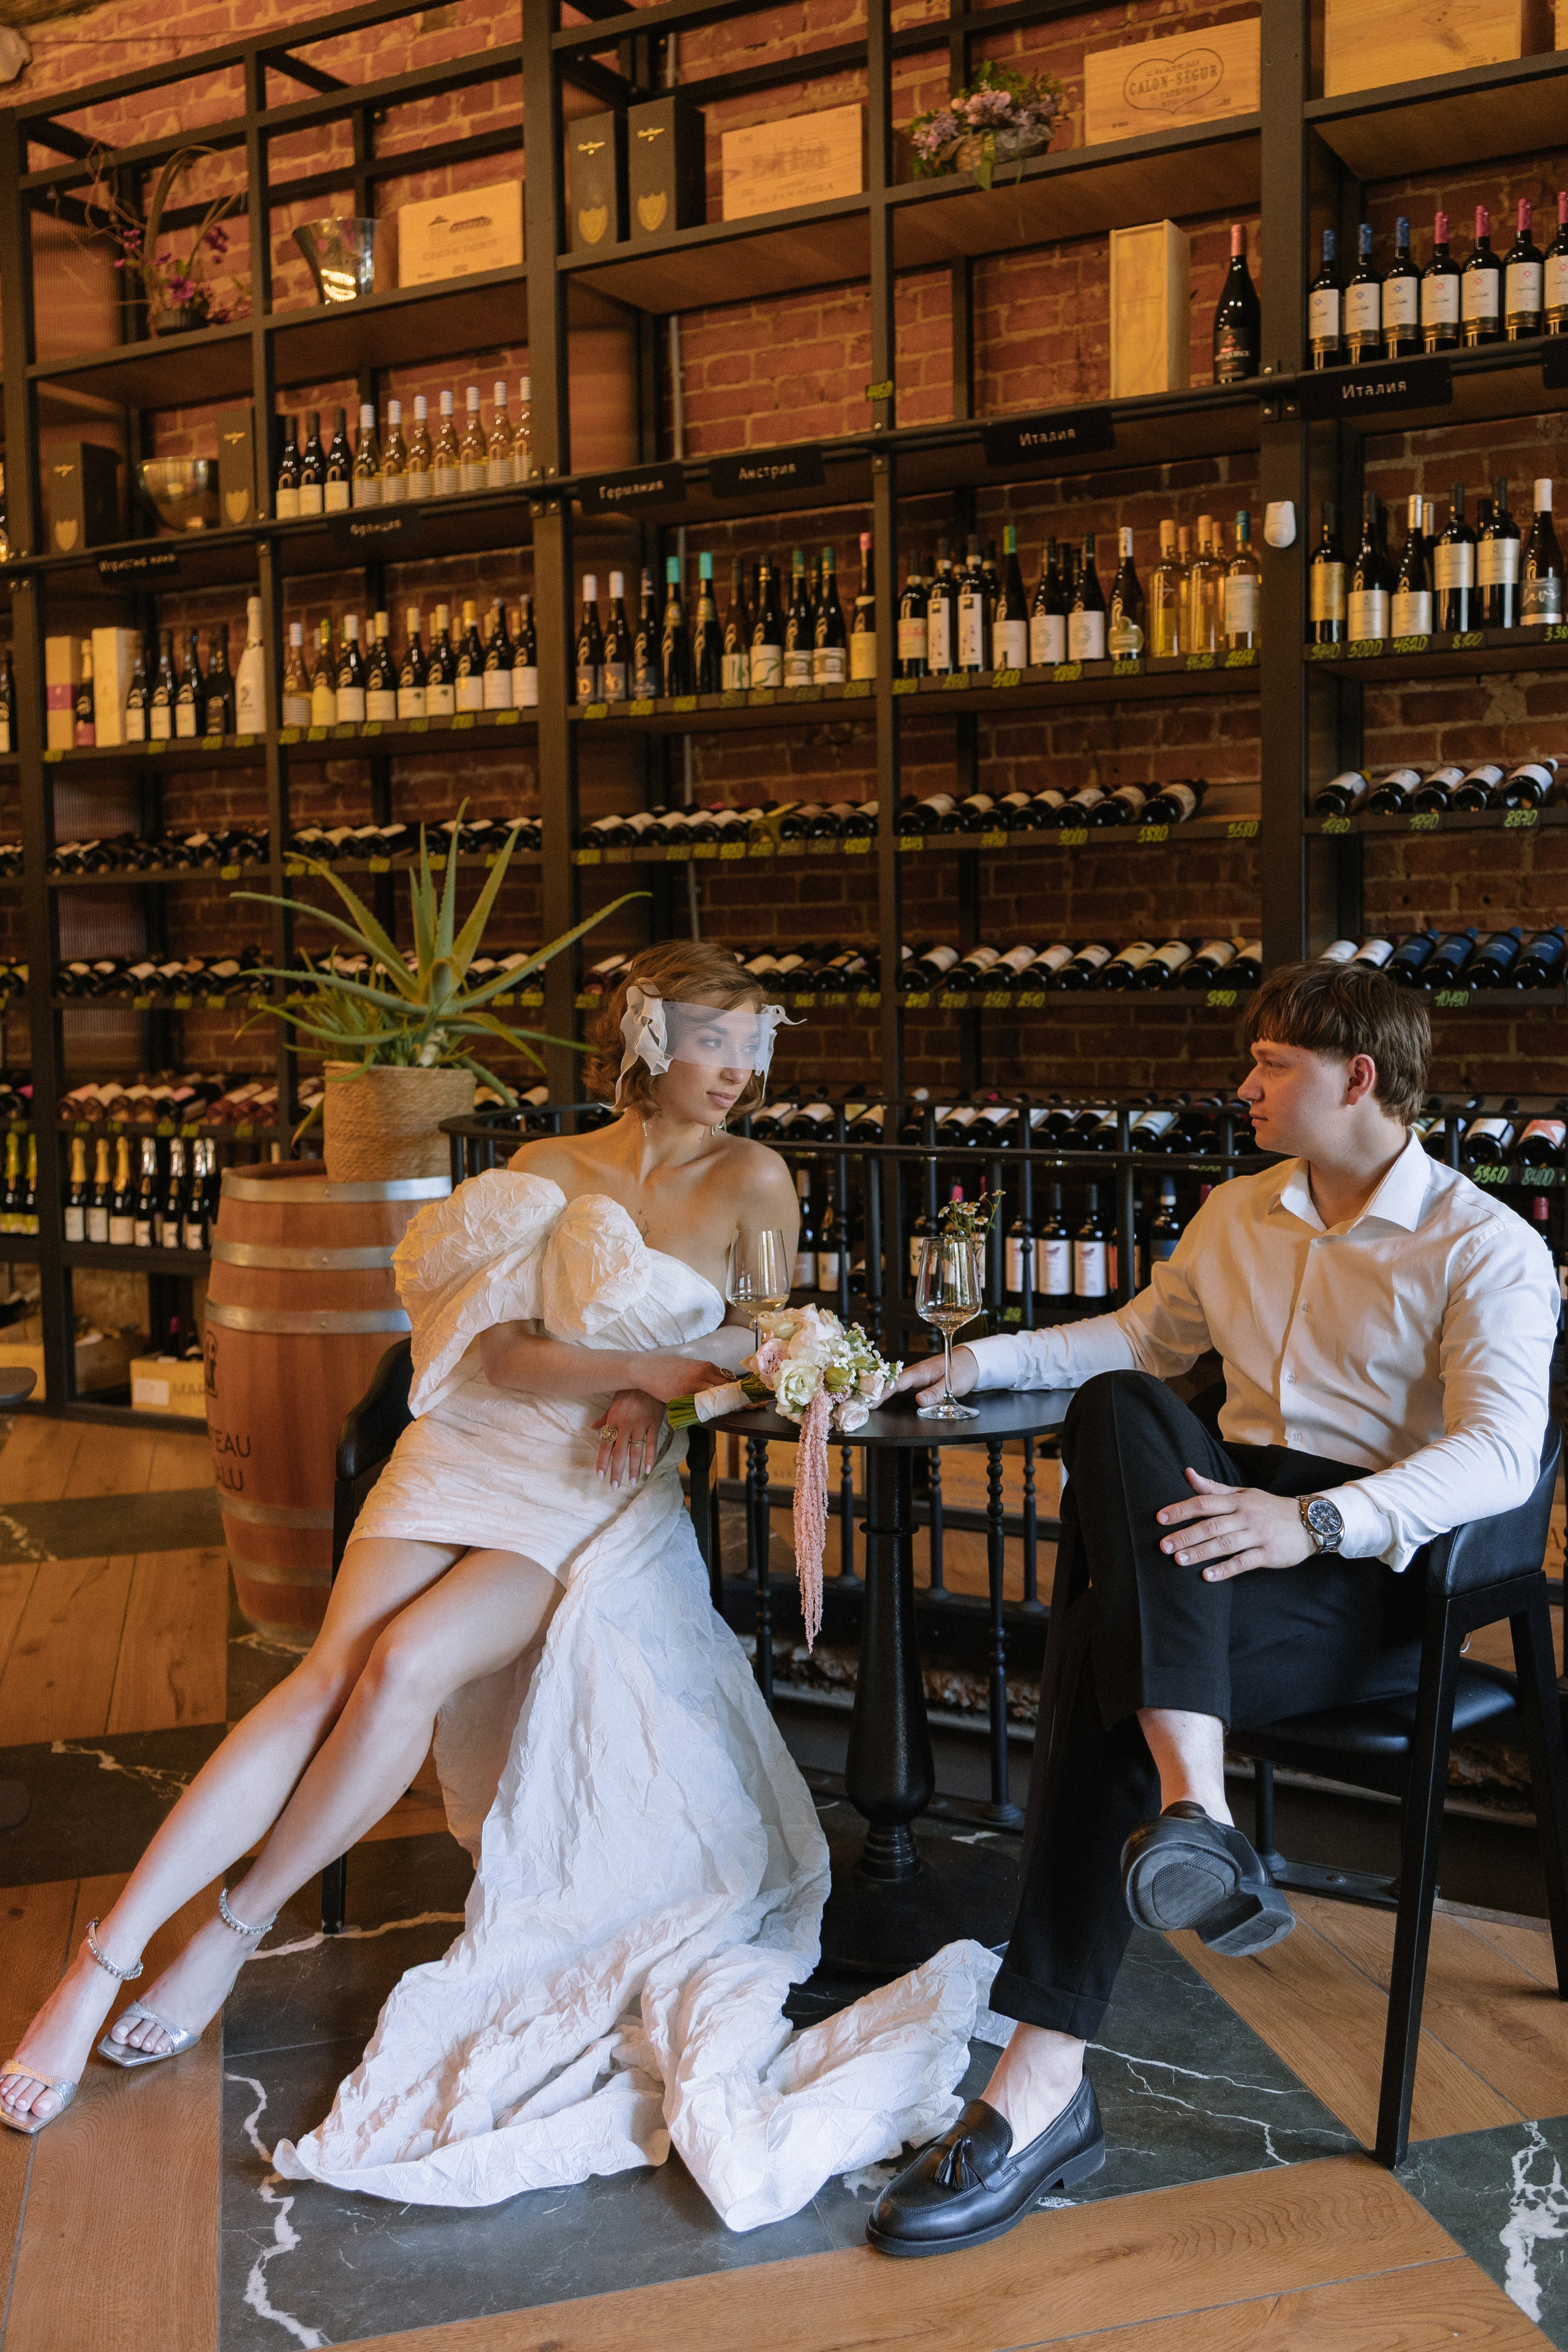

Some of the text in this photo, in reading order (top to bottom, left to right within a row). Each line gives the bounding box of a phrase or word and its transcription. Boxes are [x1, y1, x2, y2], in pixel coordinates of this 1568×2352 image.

[1341, 380, 1407, 399] Италия
[1019, 428, 1076, 447] Италия
[738, 462, 797, 480] Австрия
[598, 480, 665, 501] Германия
[1348, 639, 1383, 658] 5000
[1393, 635, 1428, 654] 4620
[1472, 1164, 1509, 1184] 5360
